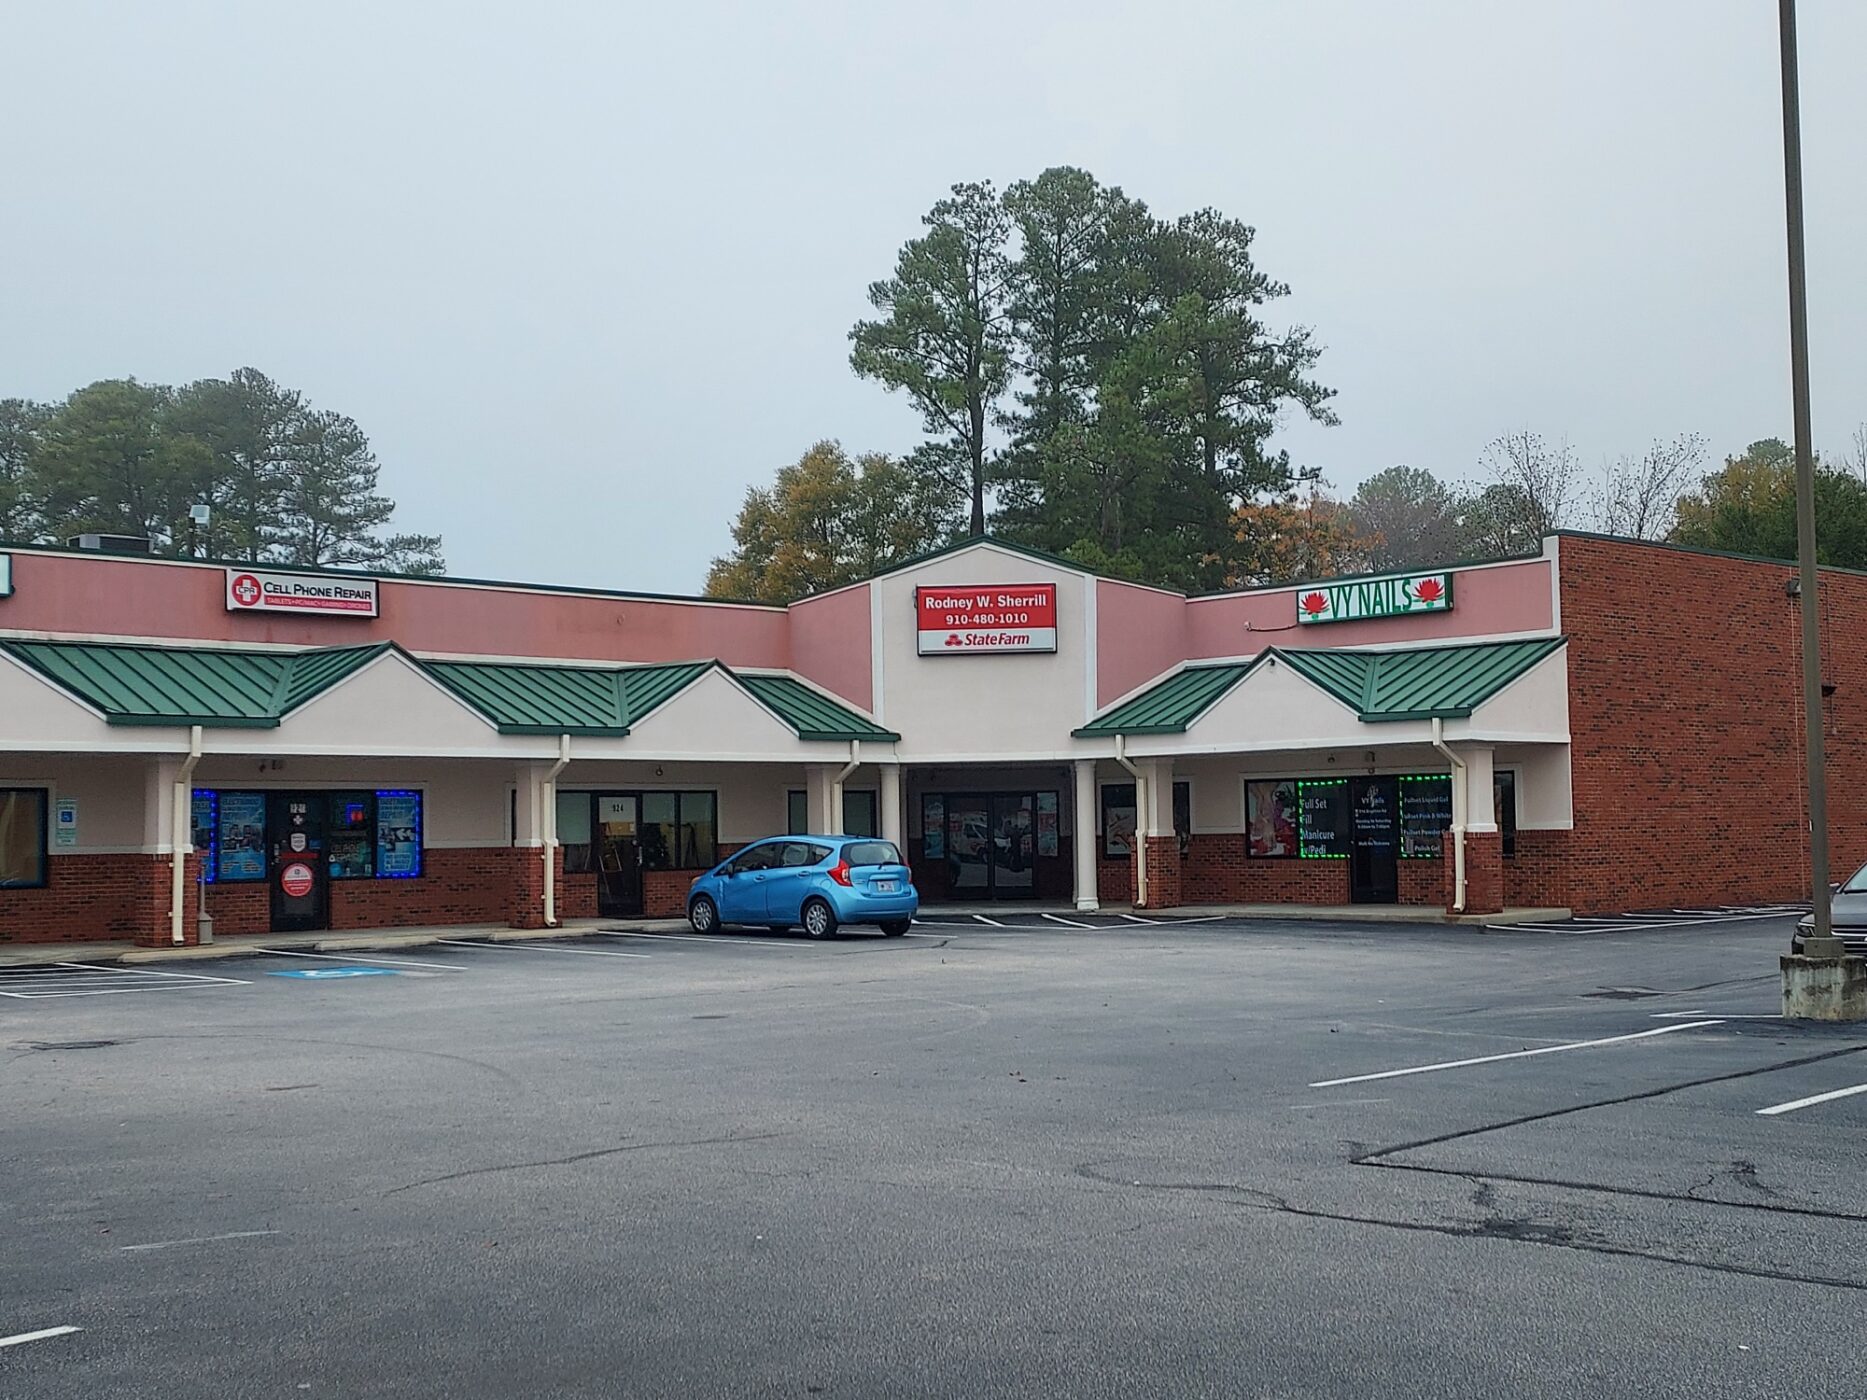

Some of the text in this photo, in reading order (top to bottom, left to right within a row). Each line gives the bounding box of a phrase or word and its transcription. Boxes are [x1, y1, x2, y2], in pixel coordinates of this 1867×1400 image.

[264, 581, 372, 600] CELL PHONE REPAIR
[1328, 579, 1412, 618] VY NAILS
[925, 594, 1047, 611] Rodney W. Sherrill
[945, 613, 1028, 625] 910-480-1010
[1315, 798, 1327, 809] Set
